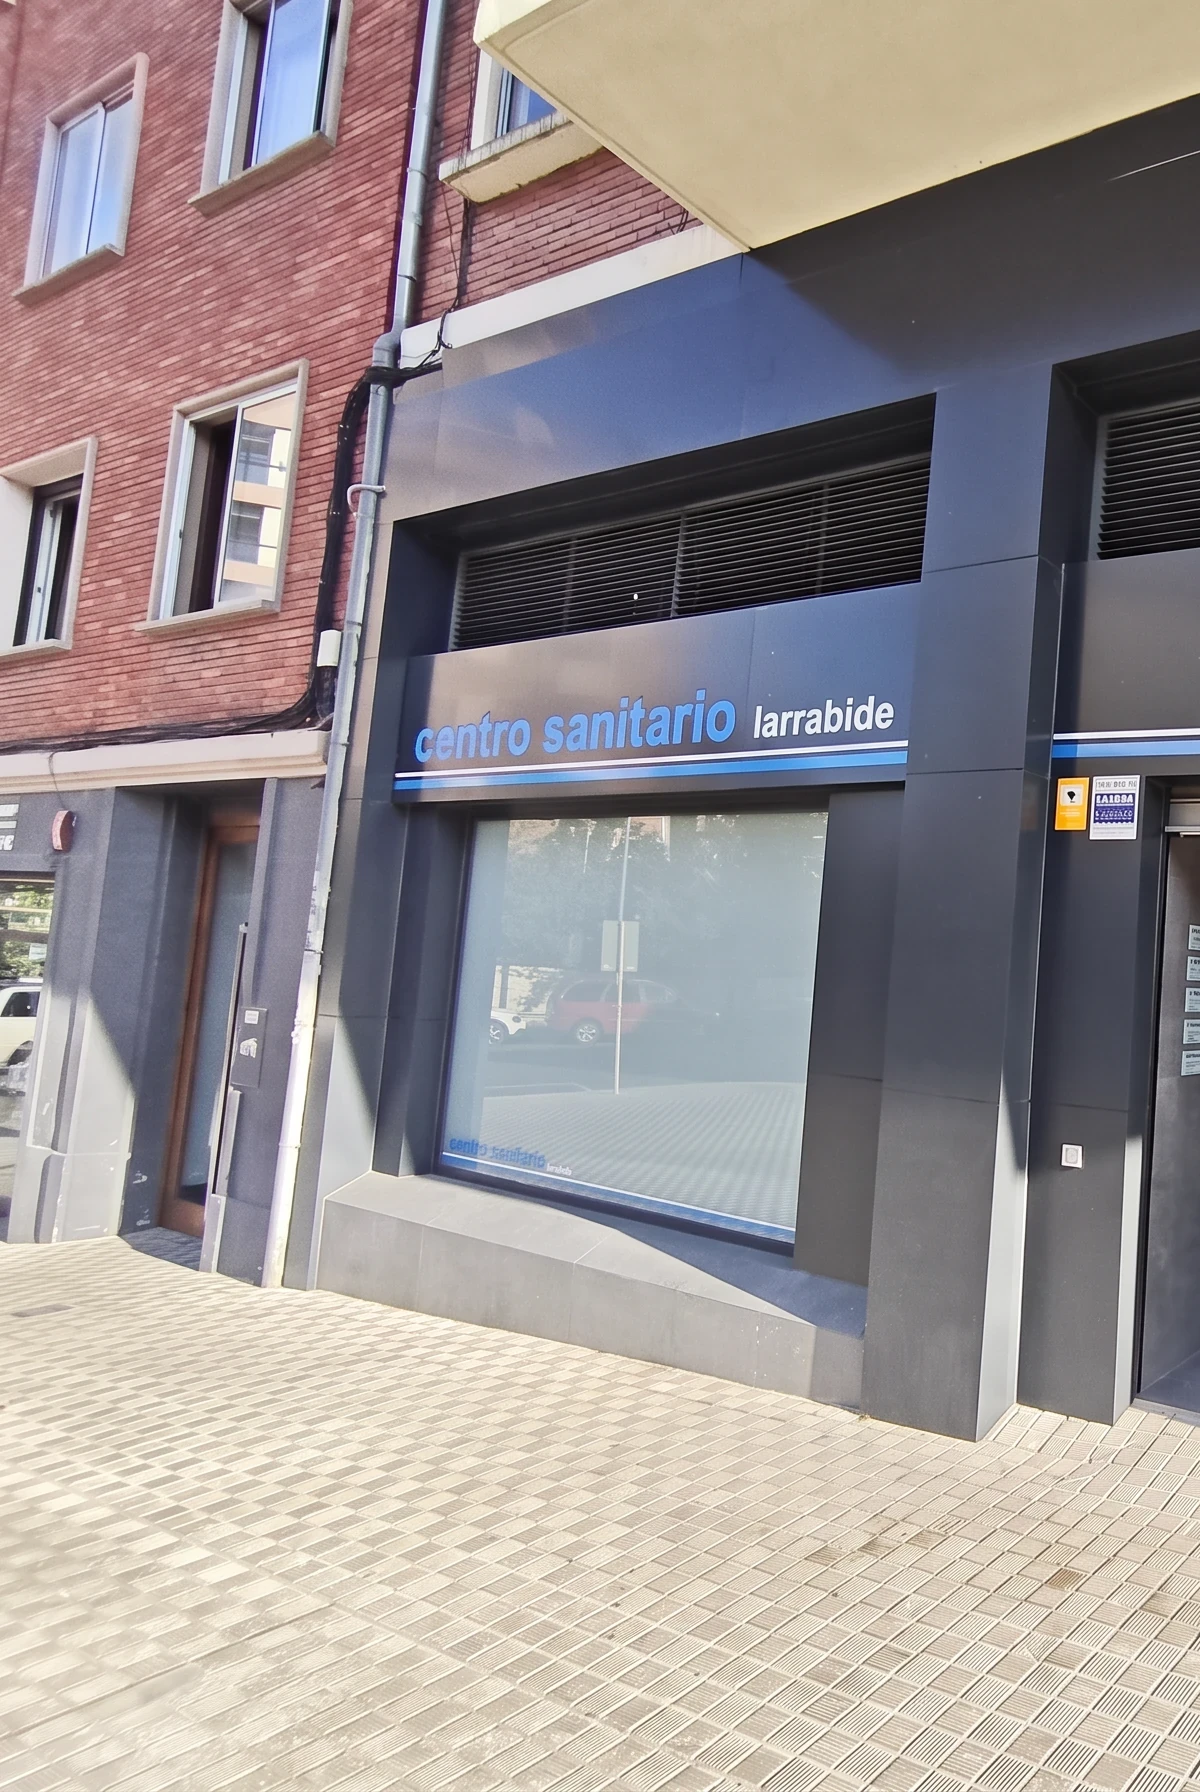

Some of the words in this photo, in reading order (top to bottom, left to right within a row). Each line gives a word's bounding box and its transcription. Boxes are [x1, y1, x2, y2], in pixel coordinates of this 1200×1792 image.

[414, 712, 531, 763] centro
[542, 688, 736, 753] sanitario
[752, 696, 894, 739] larrabide
